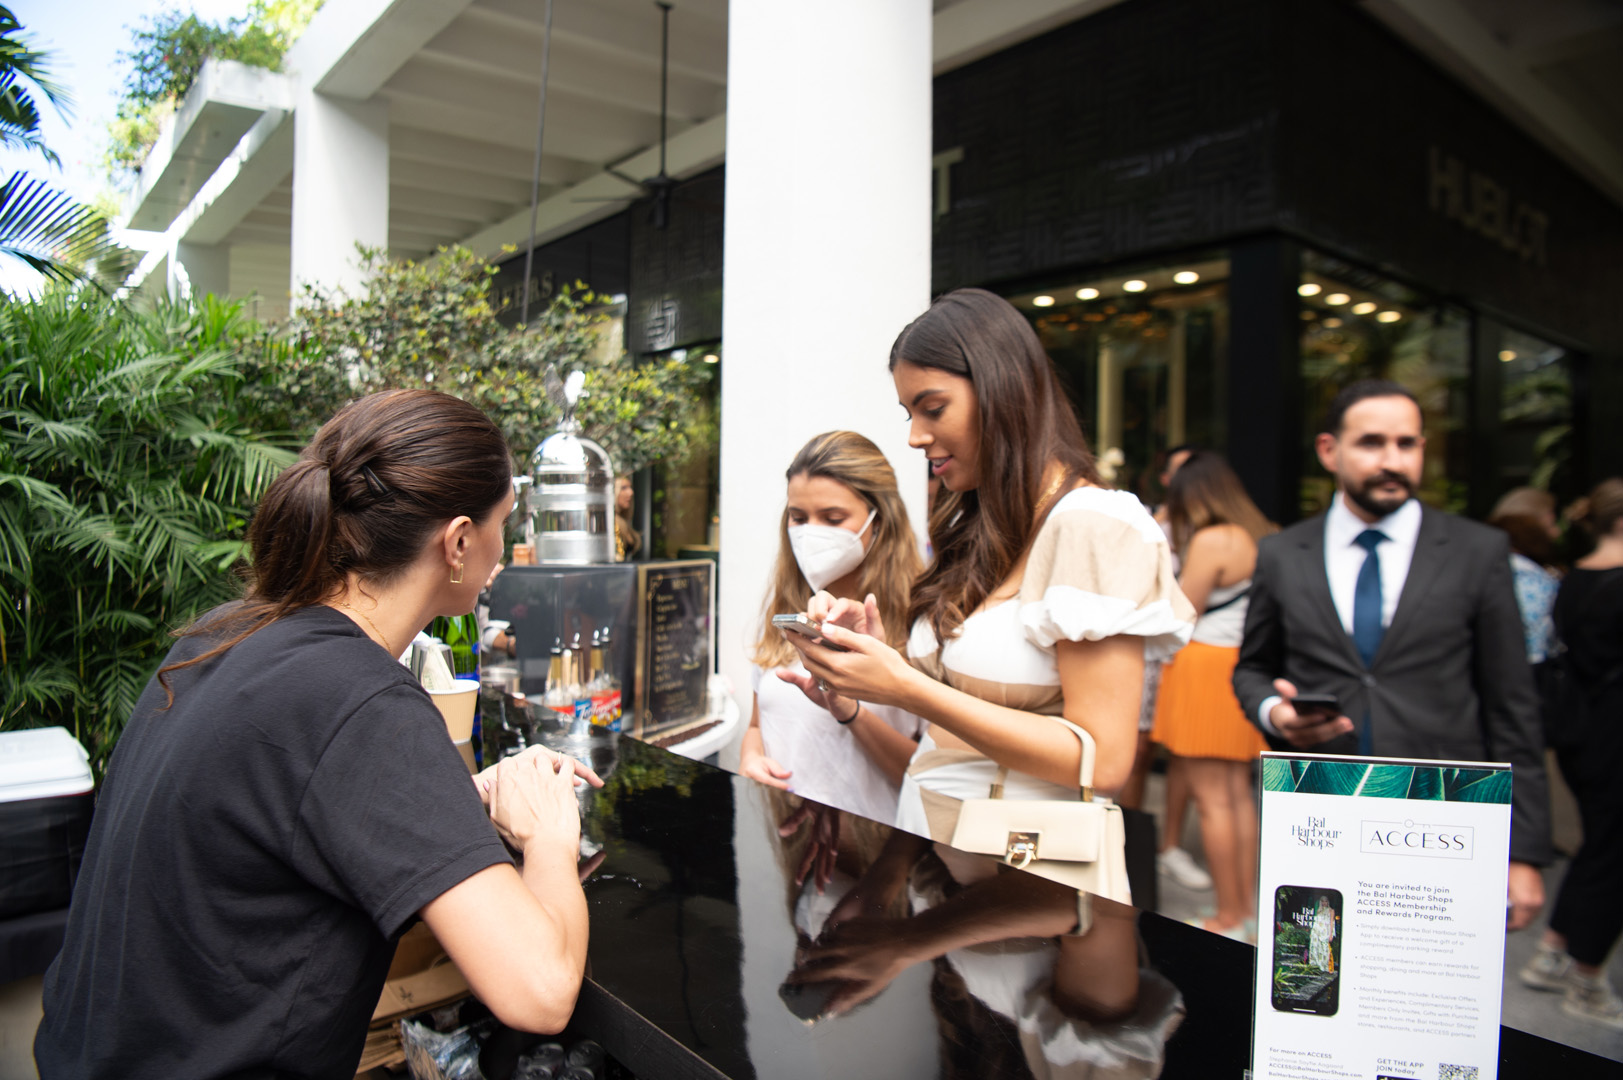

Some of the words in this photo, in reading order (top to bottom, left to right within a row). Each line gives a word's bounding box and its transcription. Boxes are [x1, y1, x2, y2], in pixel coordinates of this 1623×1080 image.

[1308, 816, 1326, 828] Bal
[1292, 825, 1342, 838] Harbour
[1298, 836, 1334, 850] Shops
[1369, 830, 1465, 850] ACCESS
[1358, 880, 1372, 888] You
[1392, 883, 1420, 892] invited
[1434, 886, 1450, 894] join
[1390, 892, 1425, 901] Harbour
[1427, 894, 1453, 904] Shops
[1357, 898, 1391, 907] ACCESS
[1393, 901, 1447, 913] Membership
[1375, 909, 1411, 918] Rewards
[1414, 912, 1454, 922] Program.
[1394, 1068, 1415, 1076] today
